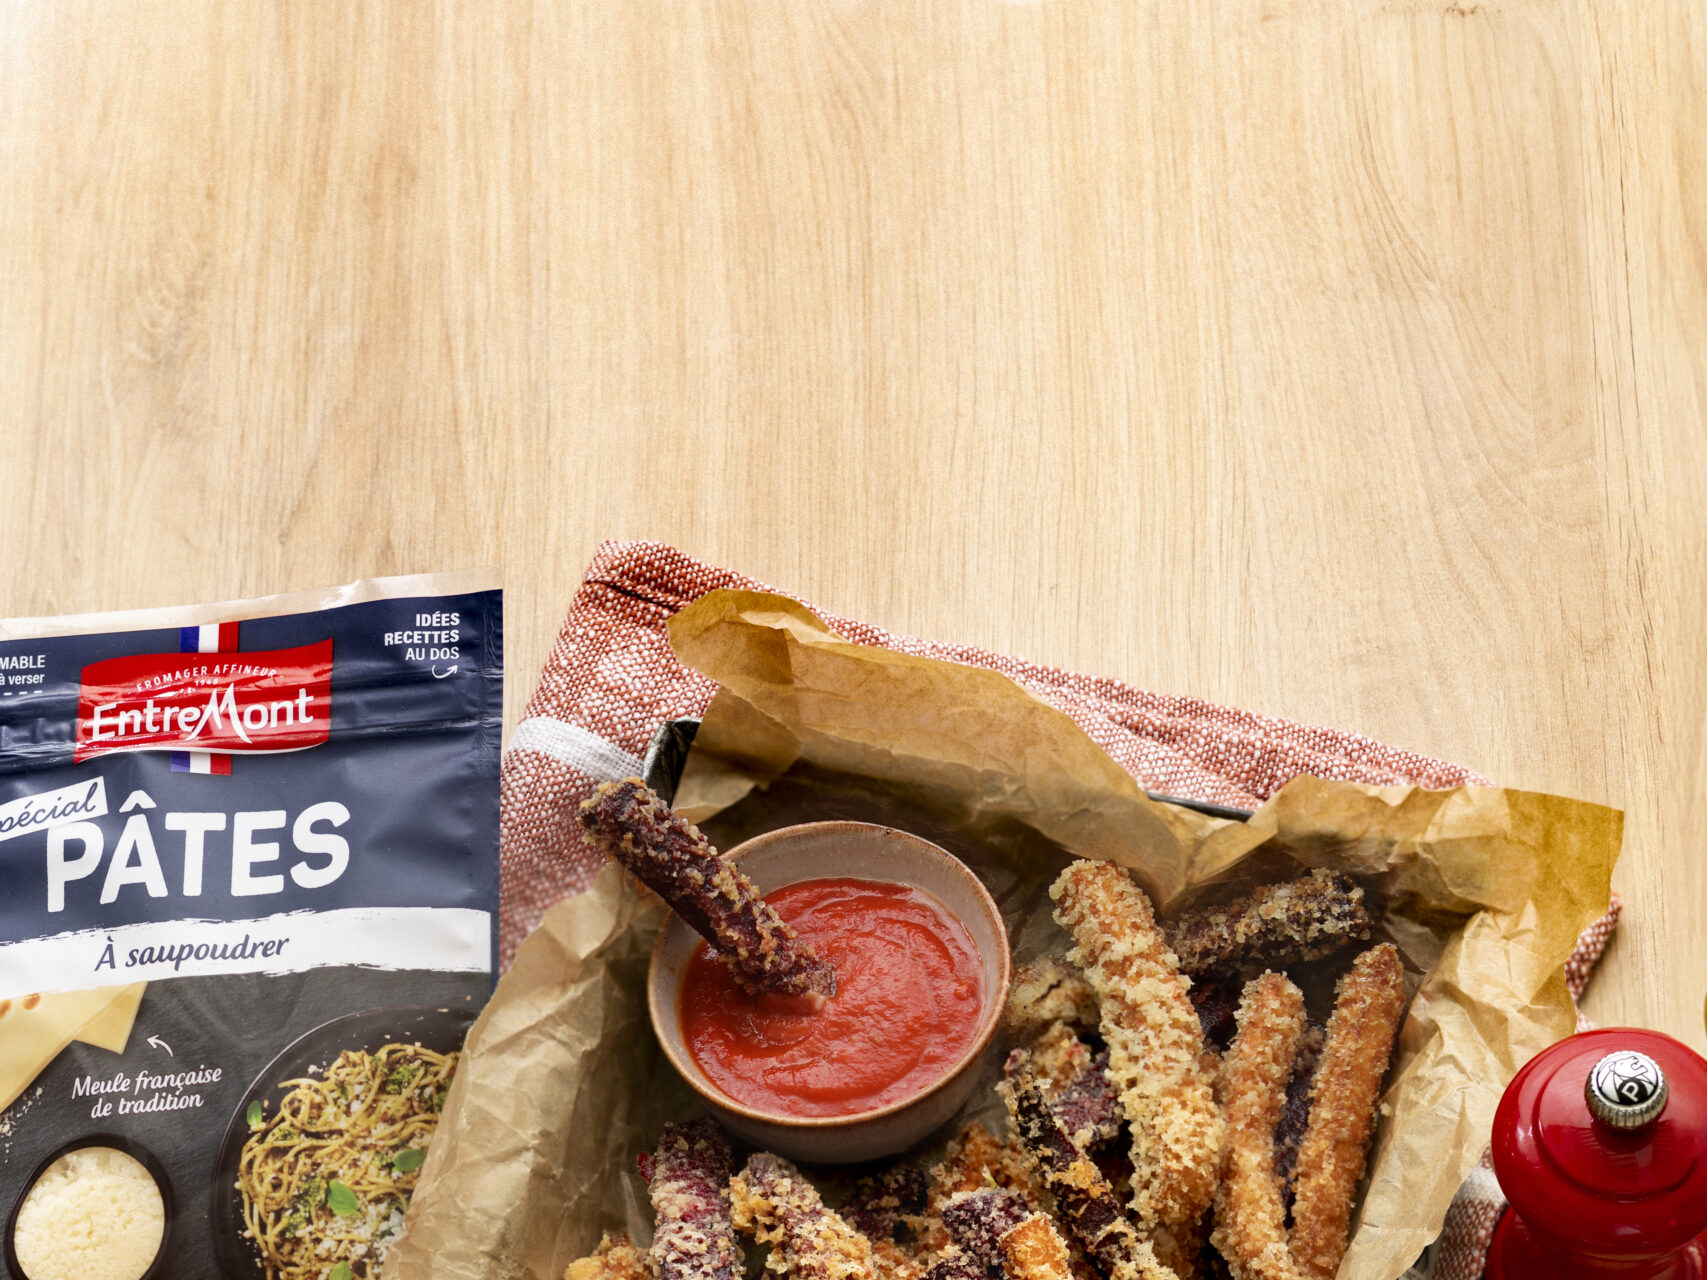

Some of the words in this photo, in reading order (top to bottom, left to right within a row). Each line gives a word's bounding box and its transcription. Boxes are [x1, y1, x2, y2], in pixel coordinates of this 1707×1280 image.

[415, 610, 460, 627] IDÉES
[384, 629, 460, 647] RECETTES
[0, 655, 46, 670] MABLE
[405, 647, 425, 661] AU
[430, 646, 460, 661] DOS
[8, 674, 46, 686] verser
[136, 665, 208, 692] FROMAGER
[213, 664, 277, 678] AFFINEUR
[92, 682, 314, 744] EntreMont
[47, 790, 351, 912] PÂTES
[94, 935, 117, 972] À
[125, 934, 290, 971] saupoudrer
[71, 1072, 131, 1100] Meule
[134, 1064, 223, 1096] française
[1621, 1081, 1640, 1103] P
[90, 1097, 113, 1119] de
[117, 1092, 205, 1115] tradition
